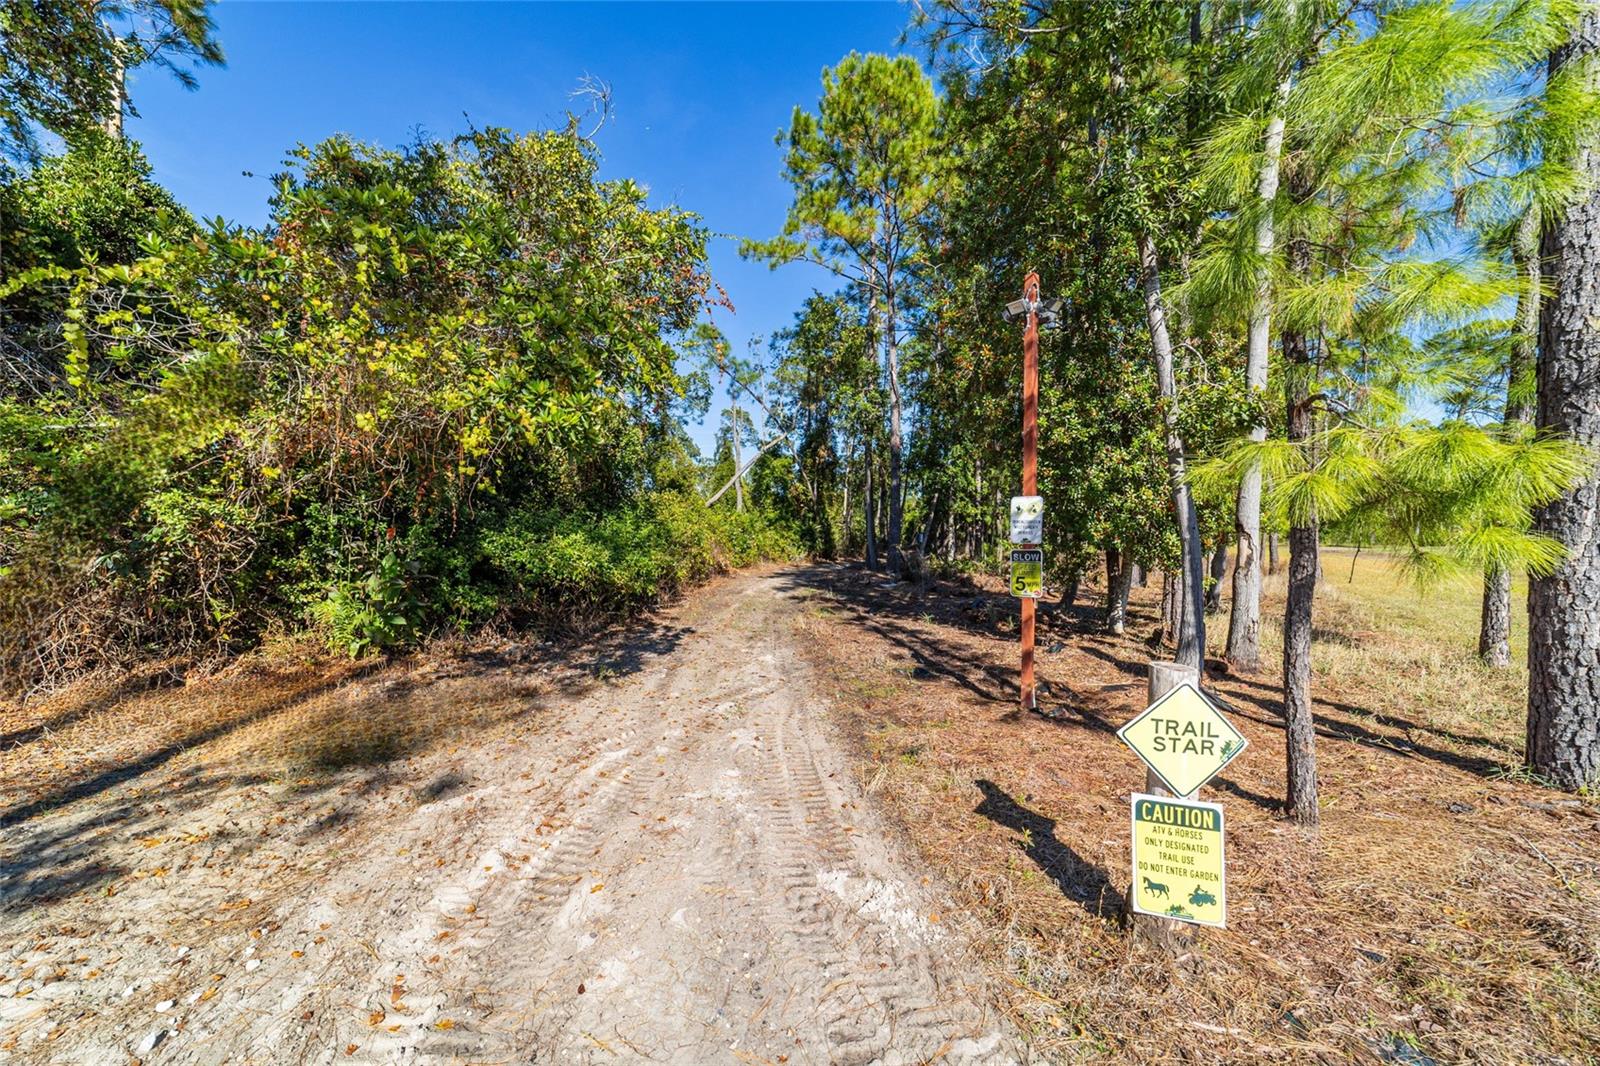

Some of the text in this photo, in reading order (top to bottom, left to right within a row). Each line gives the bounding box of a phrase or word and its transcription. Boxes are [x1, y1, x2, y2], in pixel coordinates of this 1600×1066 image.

[1013, 553, 1040, 561] SLOW
[1015, 576, 1026, 591] 5
[1151, 718, 1219, 738] TRAIL
[1153, 736, 1214, 756] STAR
[1142, 802, 1213, 829] CAUTION
[1152, 826, 1203, 840] ATV & HORSES
[1144, 837, 1209, 854] ONLY DESIGNATED
[1159, 851, 1195, 865] TRAIL USE
[1138, 861, 1219, 881] DO NOT ENTER GARDEN
